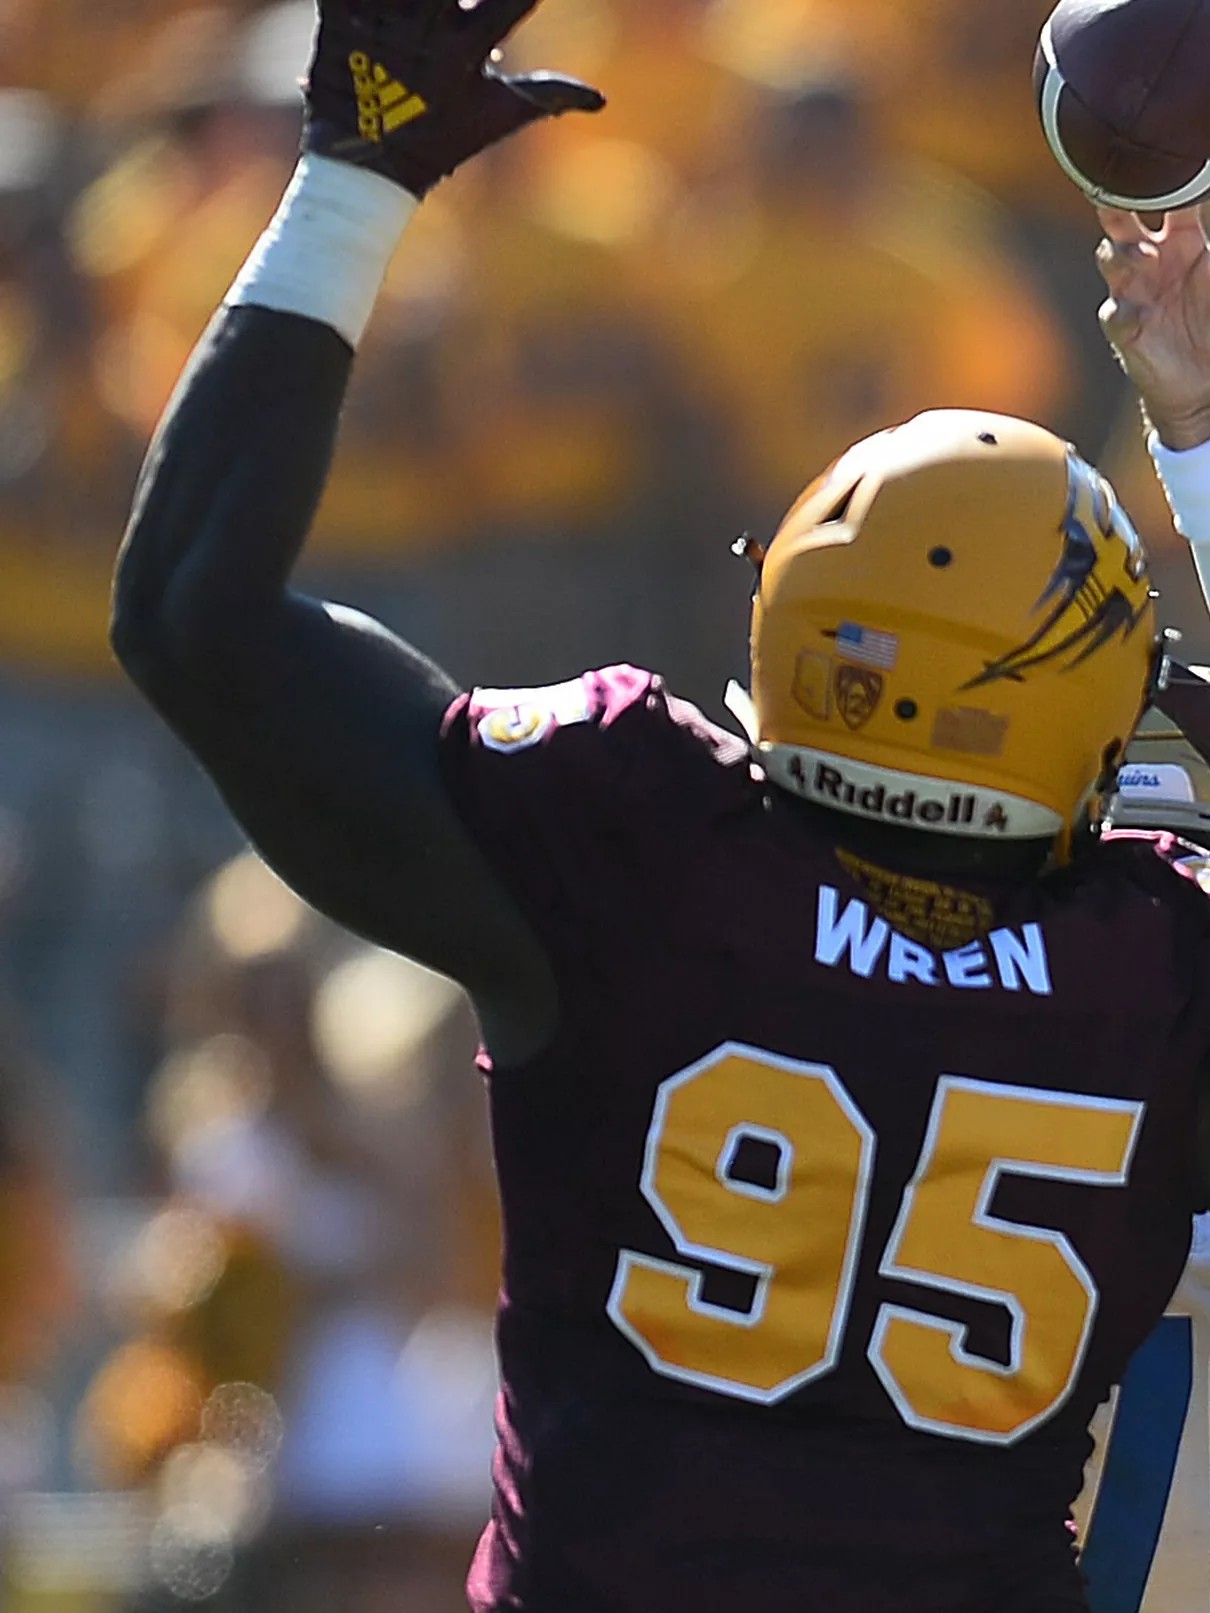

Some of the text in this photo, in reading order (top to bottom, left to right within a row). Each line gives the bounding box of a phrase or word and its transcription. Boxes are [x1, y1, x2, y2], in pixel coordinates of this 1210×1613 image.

[815, 762, 977, 824] Riddell
[1118, 769, 1161, 786] ruins
[814, 884, 1053, 995] WREN
[606, 1040, 1146, 1446] 95
